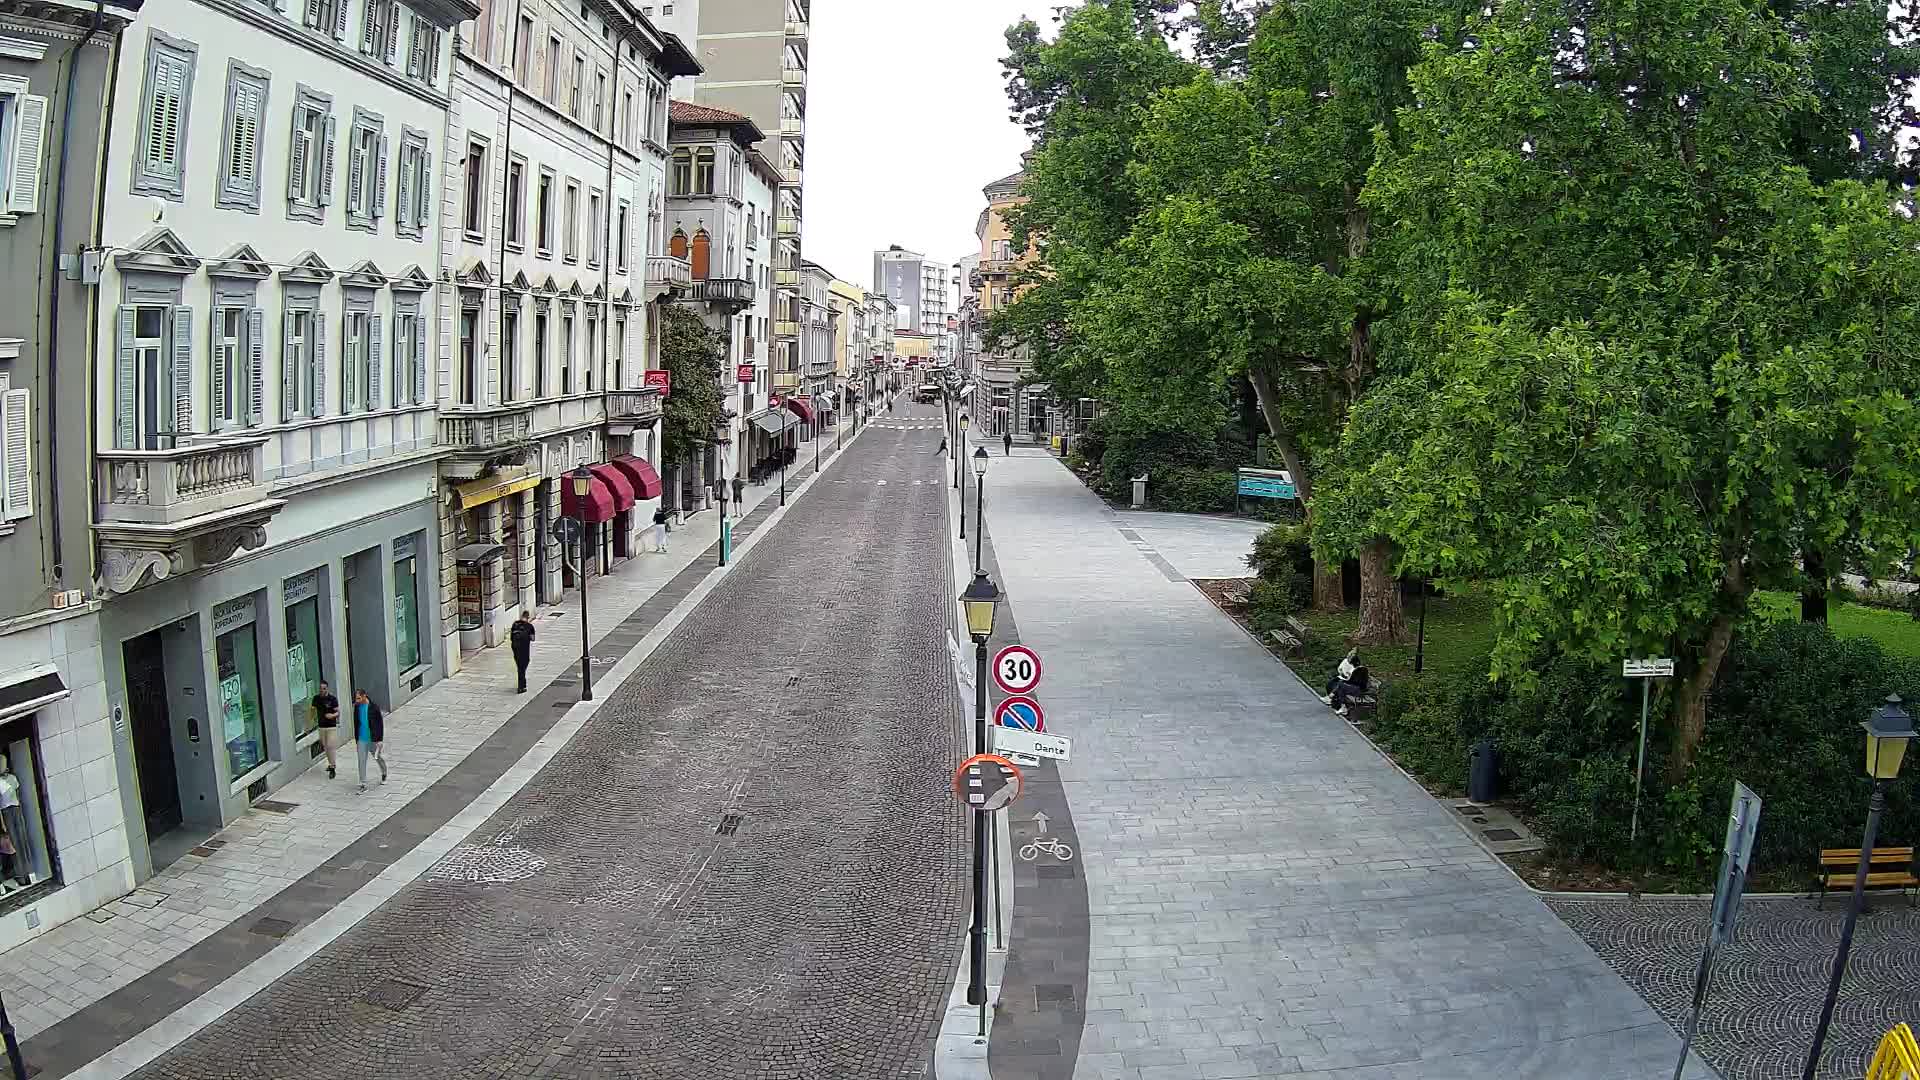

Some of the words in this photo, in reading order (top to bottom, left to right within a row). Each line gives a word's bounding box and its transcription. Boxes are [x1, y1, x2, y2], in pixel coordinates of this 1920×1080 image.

[1005, 659, 1031, 681] 30
[221, 679, 240, 701] 130
[1034, 742, 1065, 755] Dante
